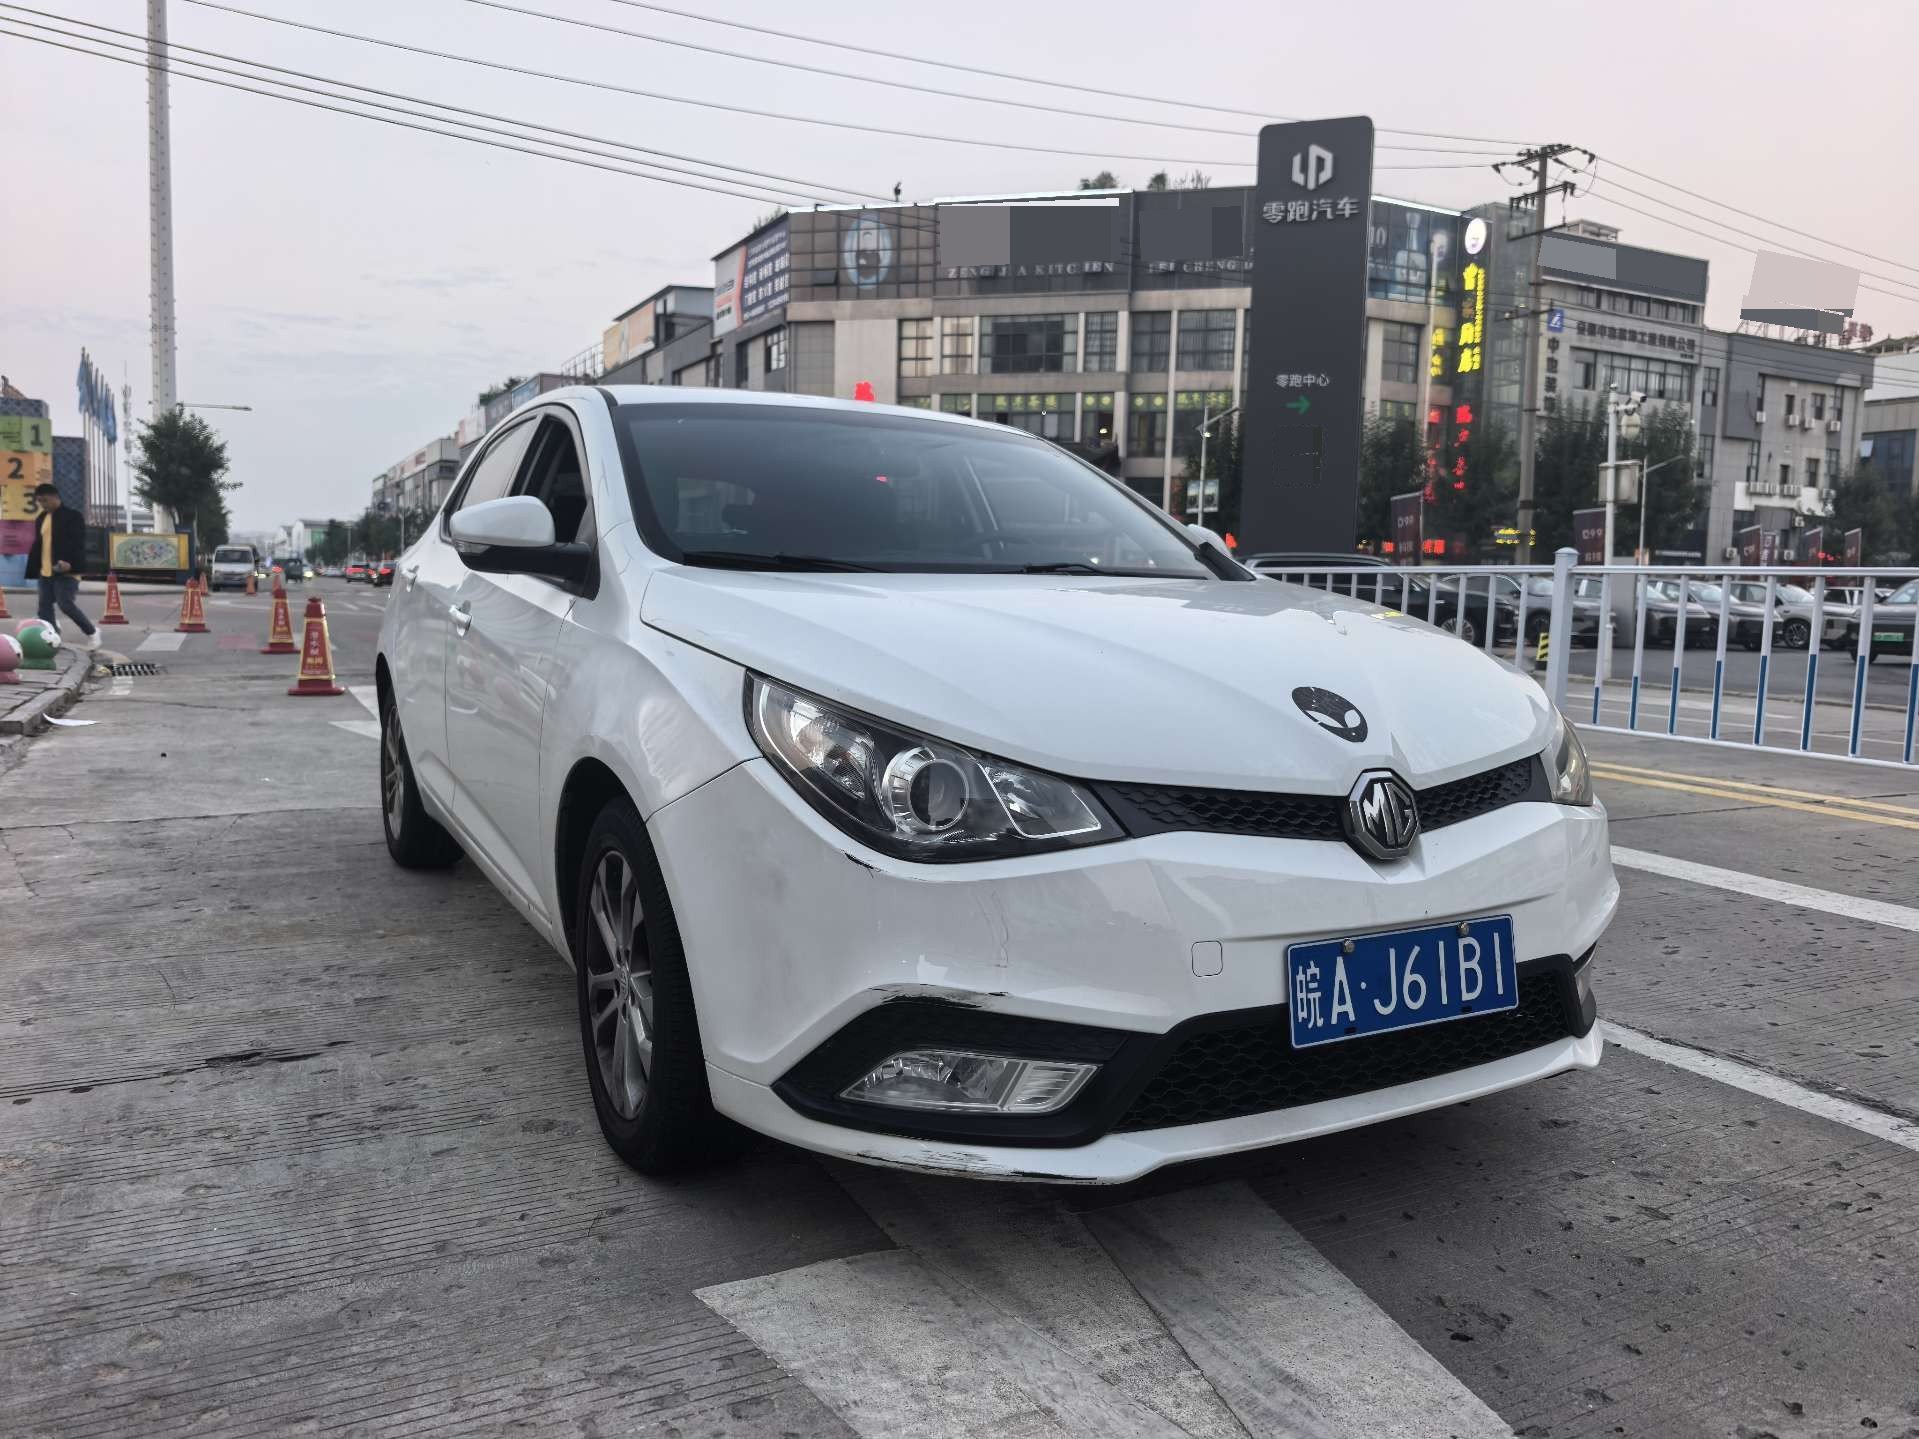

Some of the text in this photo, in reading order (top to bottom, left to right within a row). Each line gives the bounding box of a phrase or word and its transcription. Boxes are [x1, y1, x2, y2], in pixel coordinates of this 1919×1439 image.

[1263, 196, 1360, 223] 零跑汽车
[947, 265, 993, 279] ZENG
[1275, 373, 1330, 388] 零跑中心
[30, 424, 43, 447] 1
[7, 457, 25, 480] 2
[23, 492, 38, 514] 3
[1362, 782, 1414, 846] MG
